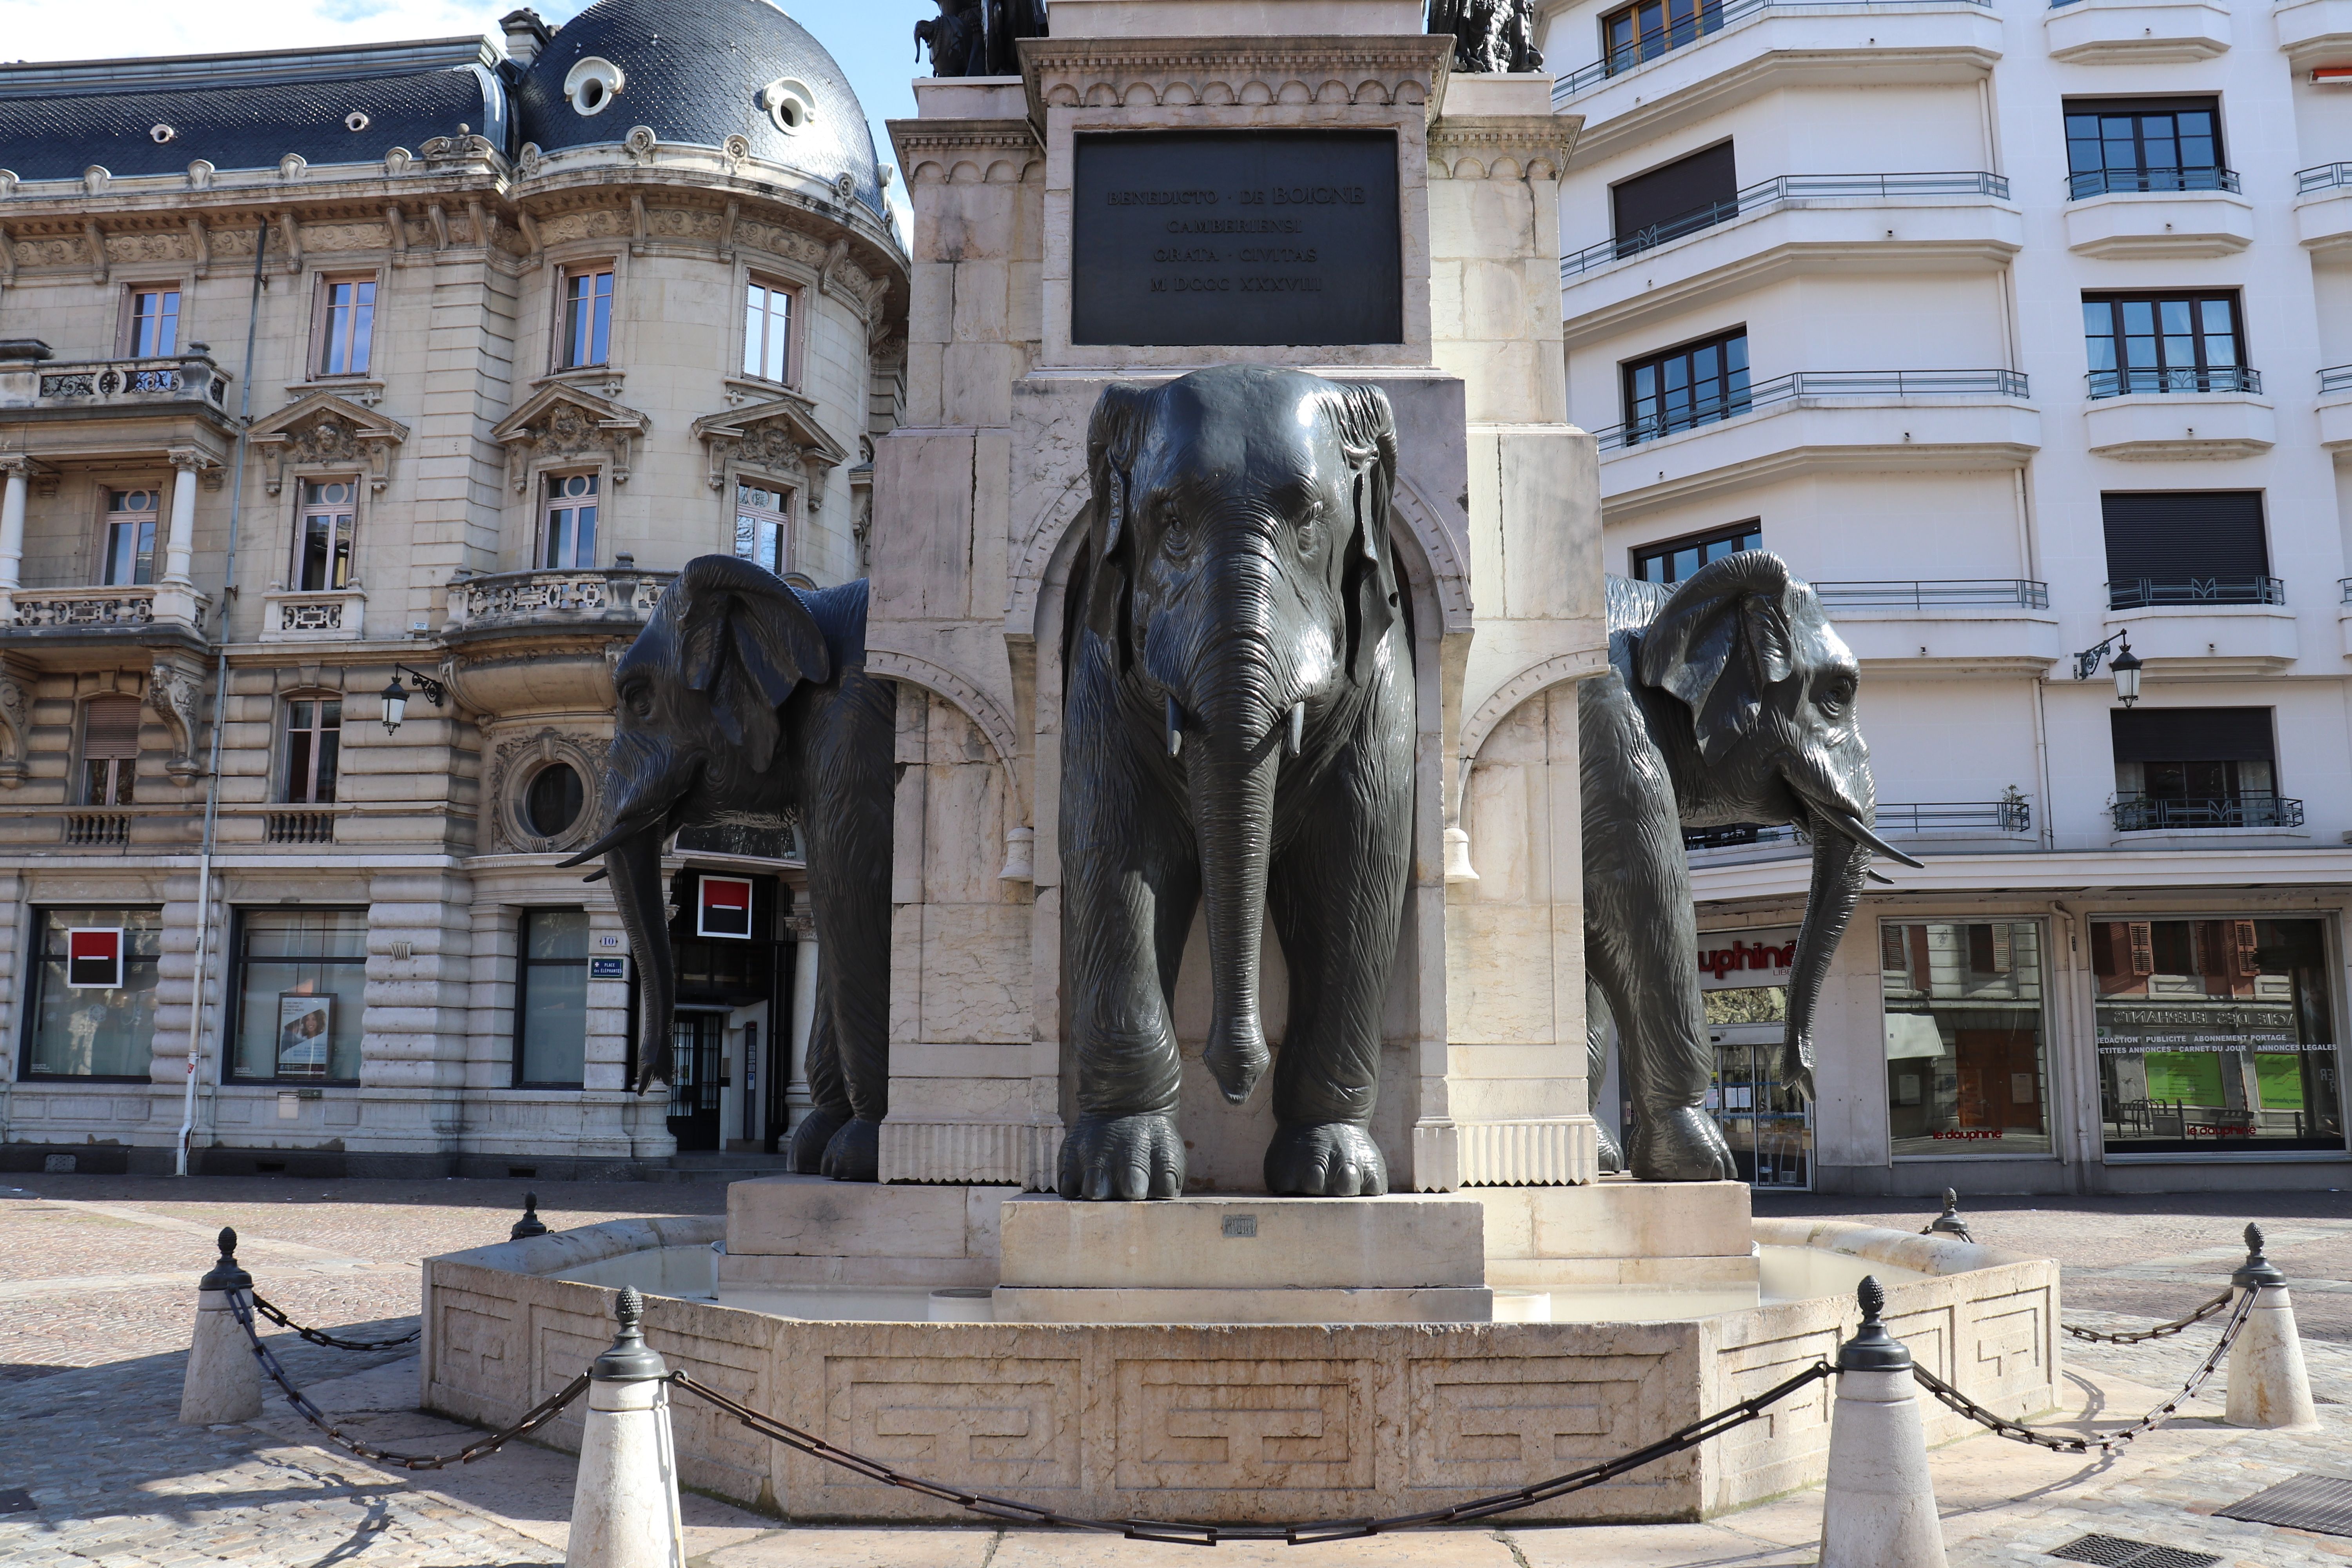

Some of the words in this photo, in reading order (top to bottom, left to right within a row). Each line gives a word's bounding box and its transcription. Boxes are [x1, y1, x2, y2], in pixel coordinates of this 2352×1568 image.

[1107, 191, 1218, 205] BENEDICTO
[1240, 191, 1265, 204] DE
[1273, 187, 1365, 204] BOIGNE
[1167, 220, 1303, 233] CAMBERIENSI
[1154, 249, 1220, 262] GRATA
[1240, 249, 1317, 262] CIVITAS
[1151, 278, 1167, 291] M
[1174, 278, 1230, 291] DCCC
[1240, 278, 1321, 291] XXXVIII
[1933, 1129, 1944, 1140] le
[2187, 1125, 2197, 1135] le
